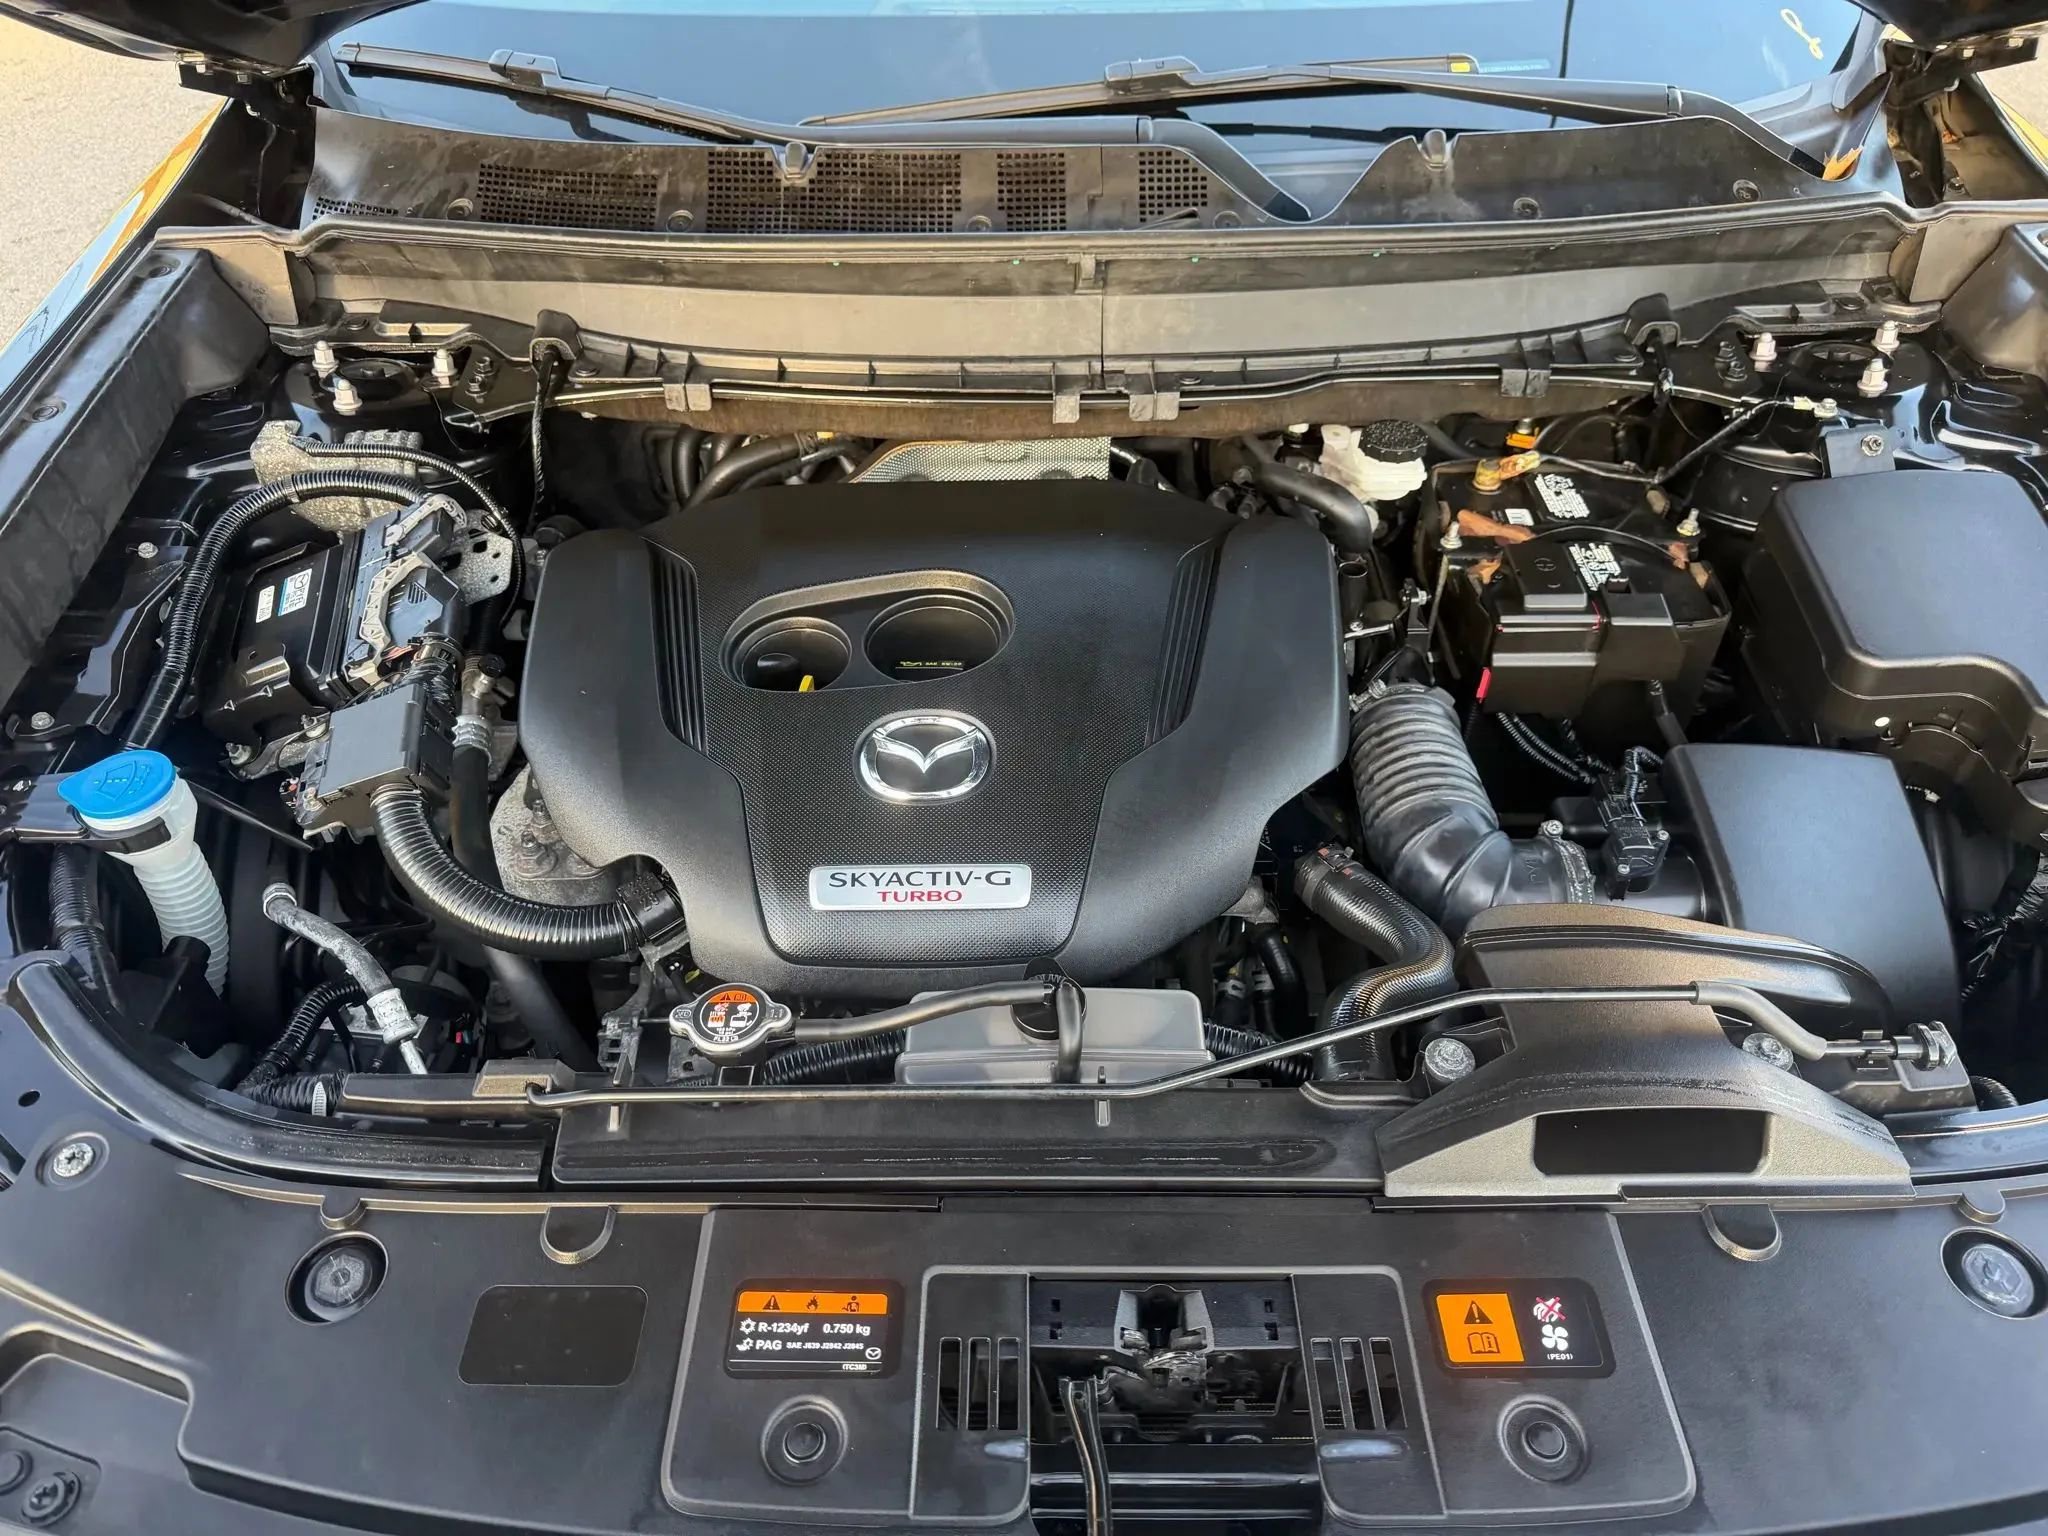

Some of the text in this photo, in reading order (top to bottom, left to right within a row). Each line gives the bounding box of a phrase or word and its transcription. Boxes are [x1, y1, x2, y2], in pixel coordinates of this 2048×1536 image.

[829, 870, 1012, 888] SKYACTIV-G
[877, 890, 963, 903] TURBO
[757, 1322, 871, 1336] R-1234yf 0.750 kg
[755, 1340, 782, 1350] PAG
